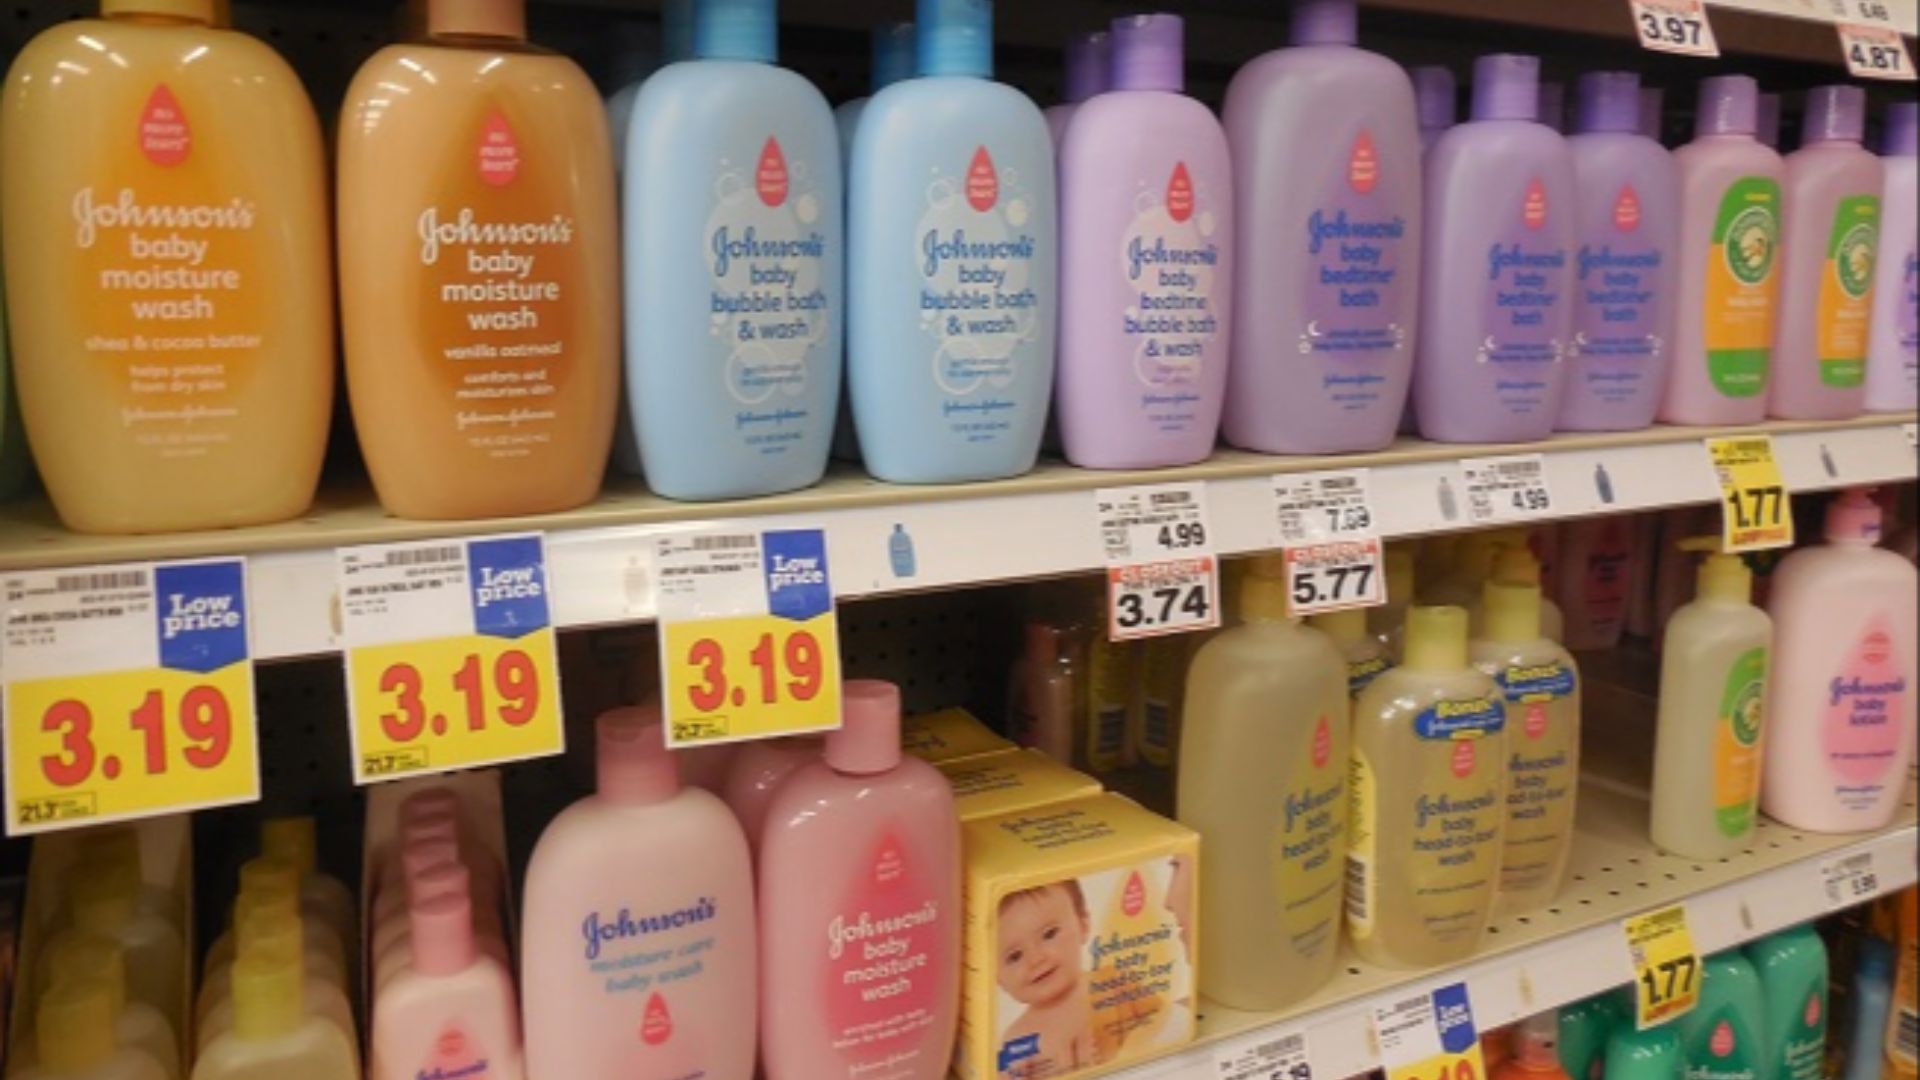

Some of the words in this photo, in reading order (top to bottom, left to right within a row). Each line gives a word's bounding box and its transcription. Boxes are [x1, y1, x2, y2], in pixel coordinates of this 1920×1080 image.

[1640, 13, 1702, 45] 3.97
[1851, 43, 1900, 70] 4.87
[72, 188, 254, 248] Johnson's
[1308, 208, 1406, 254] Johnson's
[417, 208, 573, 264] Johnson's
[130, 235, 209, 265] baby
[712, 226, 824, 277] Johnson's
[923, 229, 1034, 277] Johnson's
[1127, 236, 1219, 280] Johnson's
[1340, 242, 1383, 265] baby
[467, 250, 534, 277] baby
[751, 264, 796, 289] baby
[958, 264, 1006, 289] baby
[101, 265, 241, 291] moisture
[441, 280, 560, 302] moisture
[1159, 268, 1196, 292] baby
[132, 295, 214, 320] wash
[711, 291, 782, 313] bubble
[787, 289, 828, 310] bath
[920, 290, 991, 311] bubble
[994, 288, 1038, 308] bath
[1140, 291, 1208, 310] bedtime
[1340, 288, 1380, 307] bath
[467, 307, 538, 331] wash
[738, 320, 755, 341] &
[758, 317, 809, 339] wash
[946, 315, 963, 335] &
[967, 314, 1017, 333] wash
[1124, 314, 1183, 333] bubble
[1187, 314, 1219, 333] bath
[86, 336, 129, 351] shea
[134, 336, 149, 350] &
[151, 337, 205, 350] cocoa
[208, 334, 261, 349] butter
[444, 344, 498, 358] vanilla
[501, 341, 562, 356] oatmeal
[1145, 338, 1161, 356] &
[1164, 338, 1203, 357] wash
[170, 379, 194, 394] dry
[199, 378, 226, 390] skin
[1511, 488, 1549, 510] 4.99
[1727, 485, 1783, 528] 1.77
[1158, 522, 1207, 549] 4.99
[480, 566, 534, 587] Low
[771, 555, 818, 573] Low
[768, 569, 825, 592] price
[1293, 565, 1374, 604] 5.77
[168, 593, 233, 617] Low
[475, 582, 542, 608] price
[1116, 585, 1209, 627] 3.74
[162, 610, 242, 639] price
[687, 629, 823, 712] 3.19
[379, 649, 540, 743] 3.19
[1829, 676, 1906, 706] Johnson's
[40, 684, 232, 787] 3.19
[582, 897, 717, 960] Johnson's
[828, 901, 938, 960] Johnson's
[590, 949, 674, 973] moisture
[677, 936, 718, 956] care
[864, 935, 910, 960] baby
[1090, 923, 1172, 972] Johnson's
[843, 952, 928, 984] moisture
[1115, 953, 1148, 970] baby
[605, 974, 653, 993] baby
[657, 960, 704, 984] wash
[861, 977, 912, 1001] wash
[1641, 953, 1696, 1005] 1.77
